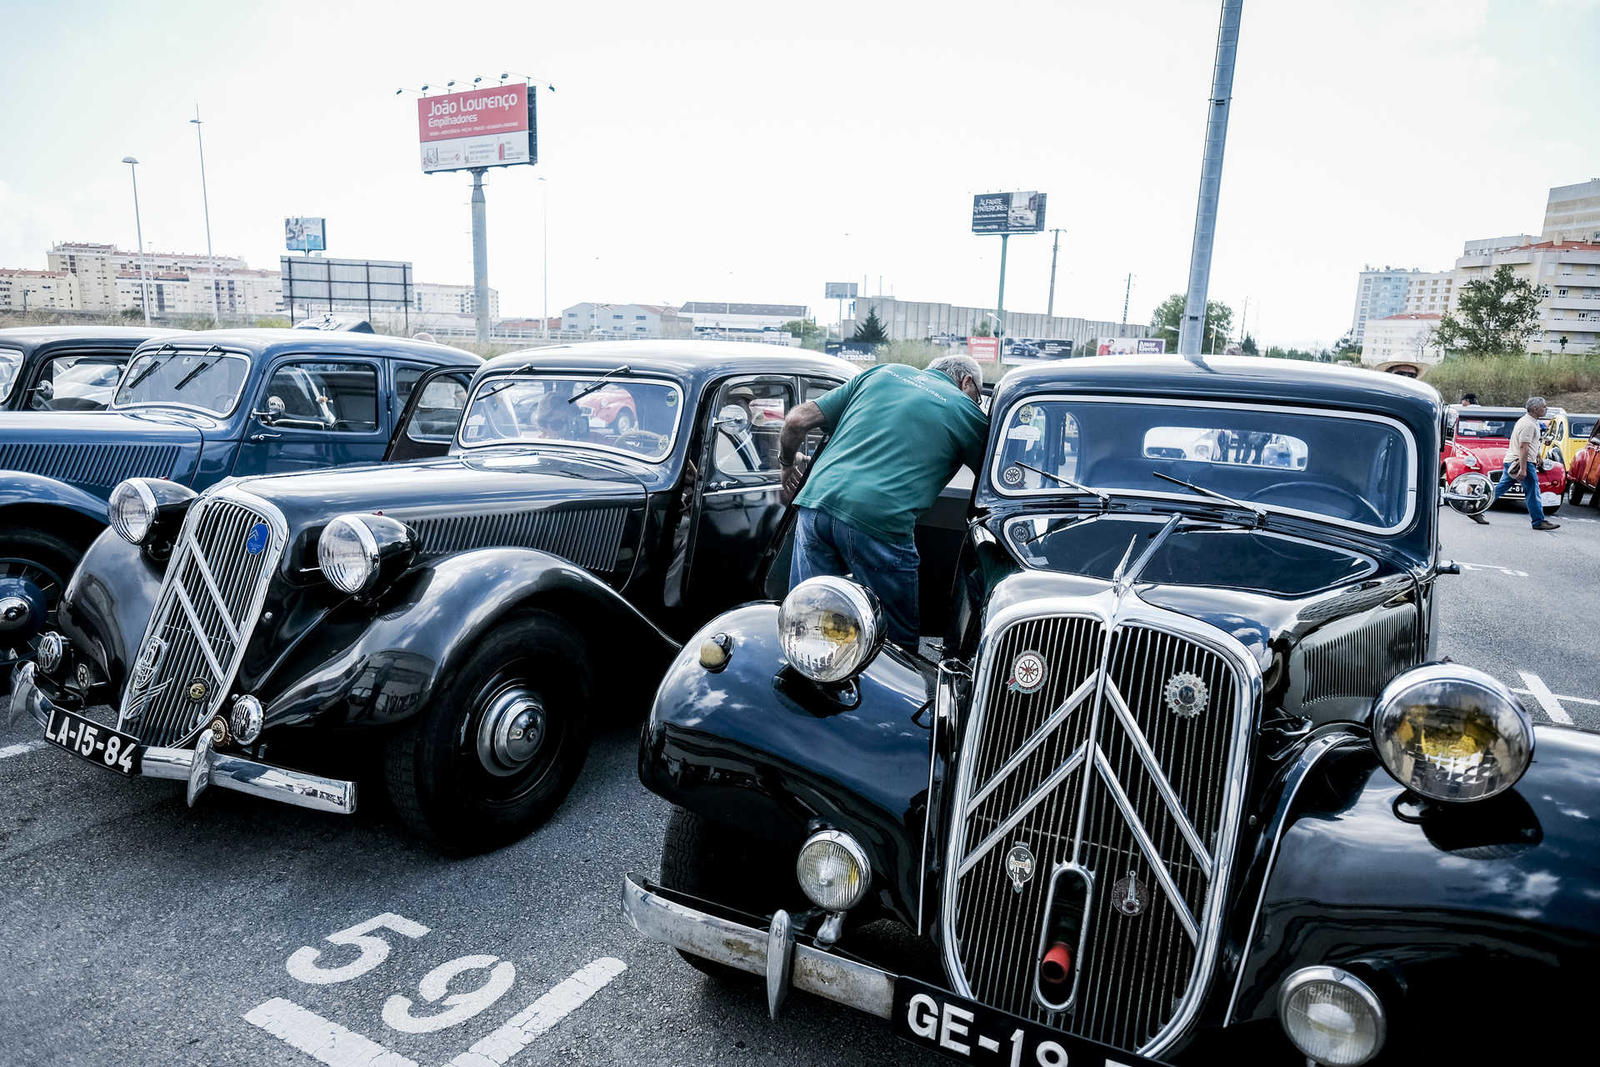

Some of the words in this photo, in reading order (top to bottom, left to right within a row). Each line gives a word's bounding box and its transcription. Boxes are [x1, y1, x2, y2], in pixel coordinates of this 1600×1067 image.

[427, 99, 457, 117] João
[460, 93, 518, 112] Lourenço
[46, 709, 136, 774] LA-15-84
